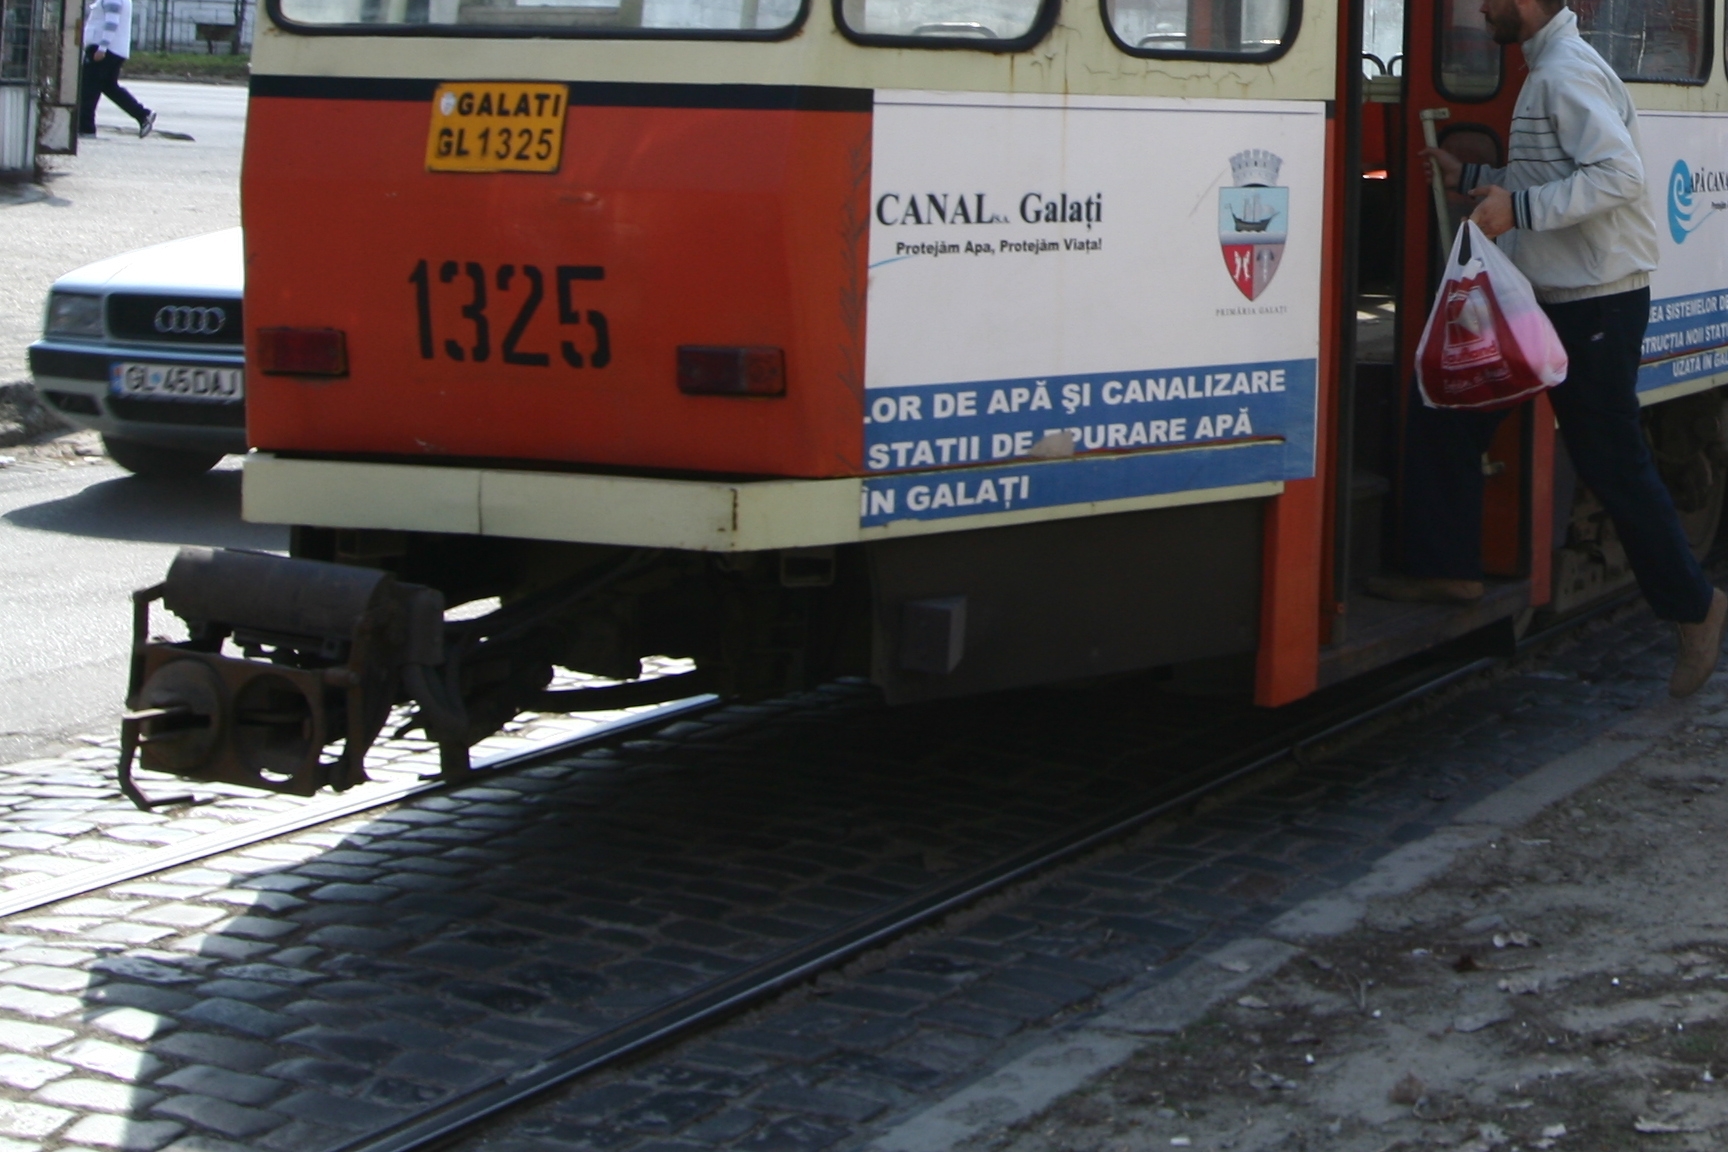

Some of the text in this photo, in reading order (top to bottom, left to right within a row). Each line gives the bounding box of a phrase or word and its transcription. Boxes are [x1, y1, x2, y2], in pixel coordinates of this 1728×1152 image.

[457, 91, 562, 117] GALATI
[437, 127, 554, 161] GL 1325
[876, 192, 993, 226] CANAL
[1019, 192, 1103, 230] Galați
[896, 241, 960, 257] Protejăm
[964, 240, 996, 258] Apa,
[1000, 238, 1060, 255] Protejăm
[408, 259, 612, 369] 1325
[1648, 305, 1665, 323] EA
[933, 391, 978, 419] DE
[986, 379, 1053, 415] APĂ
[1101, 369, 1286, 405] CANALIZARE
[992, 431, 1034, 459] DE
[1043, 417, 1187, 449] PURARE
[1194, 406, 1253, 440] APĂ
[906, 475, 1031, 512] GALAȚI
